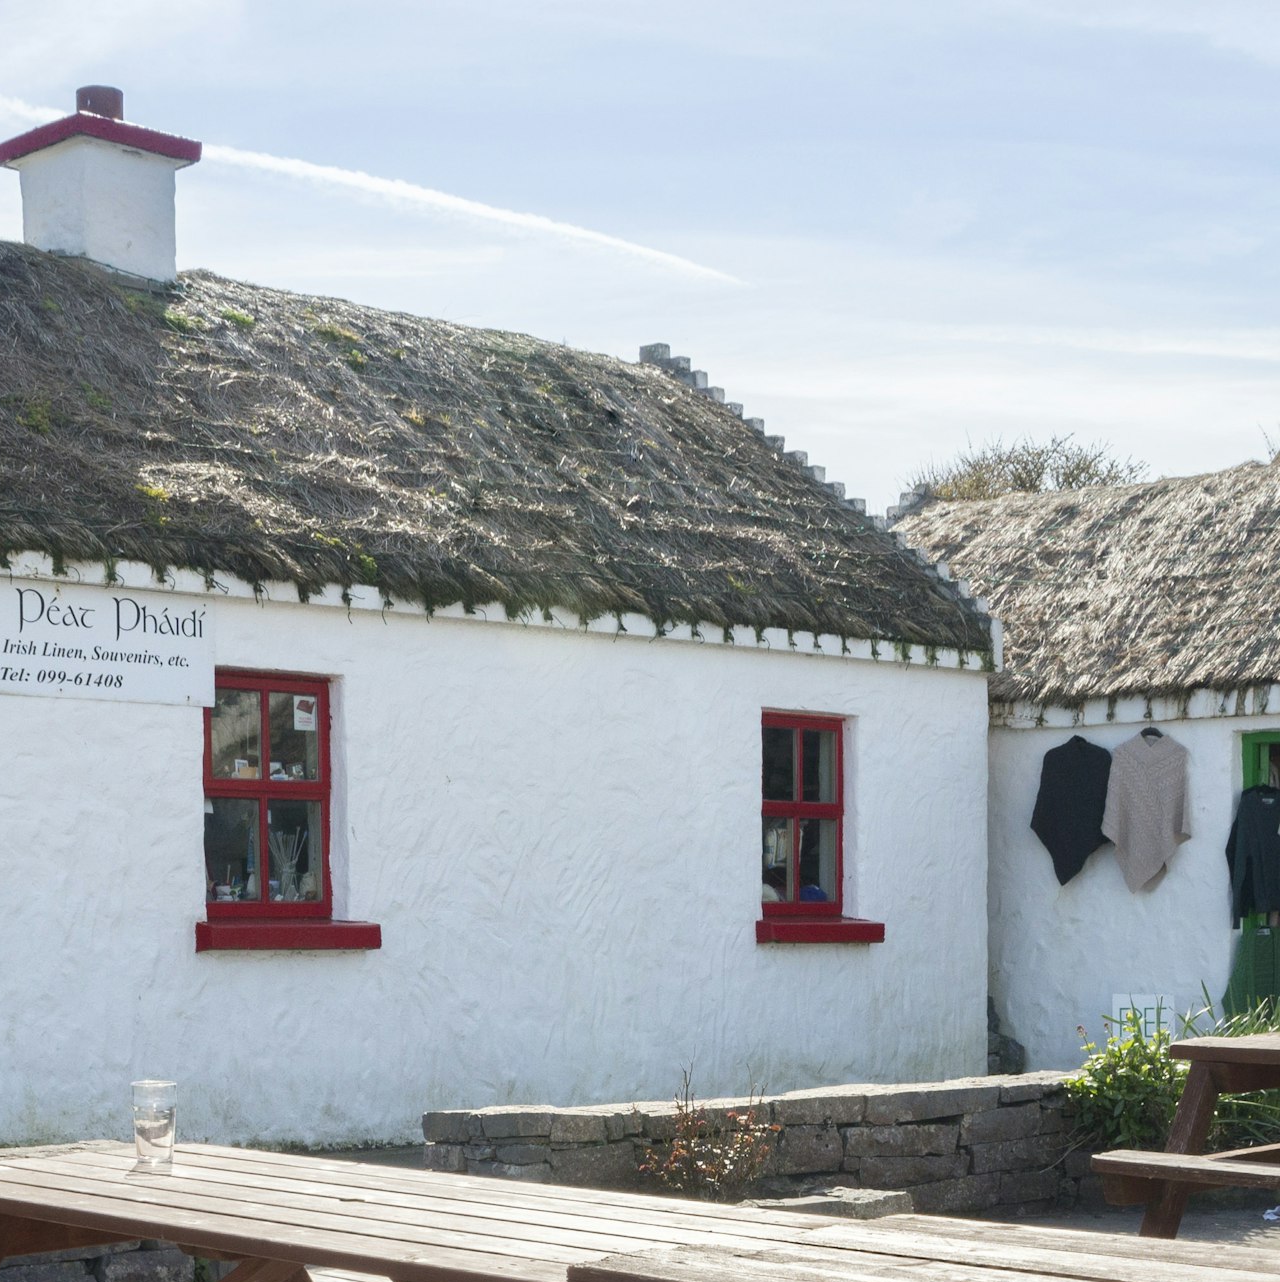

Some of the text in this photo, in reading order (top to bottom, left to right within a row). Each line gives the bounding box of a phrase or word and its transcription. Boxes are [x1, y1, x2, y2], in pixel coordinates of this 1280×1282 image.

[15, 588, 96, 633] Péat
[112, 597, 206, 641] Pháidí
[2, 638, 37, 655] Irish
[41, 641, 87, 661] Linen,
[91, 645, 163, 667] Souvenirs,
[167, 655, 190, 668] etc.
[0, 666, 124, 689] Tel: 099-61408
